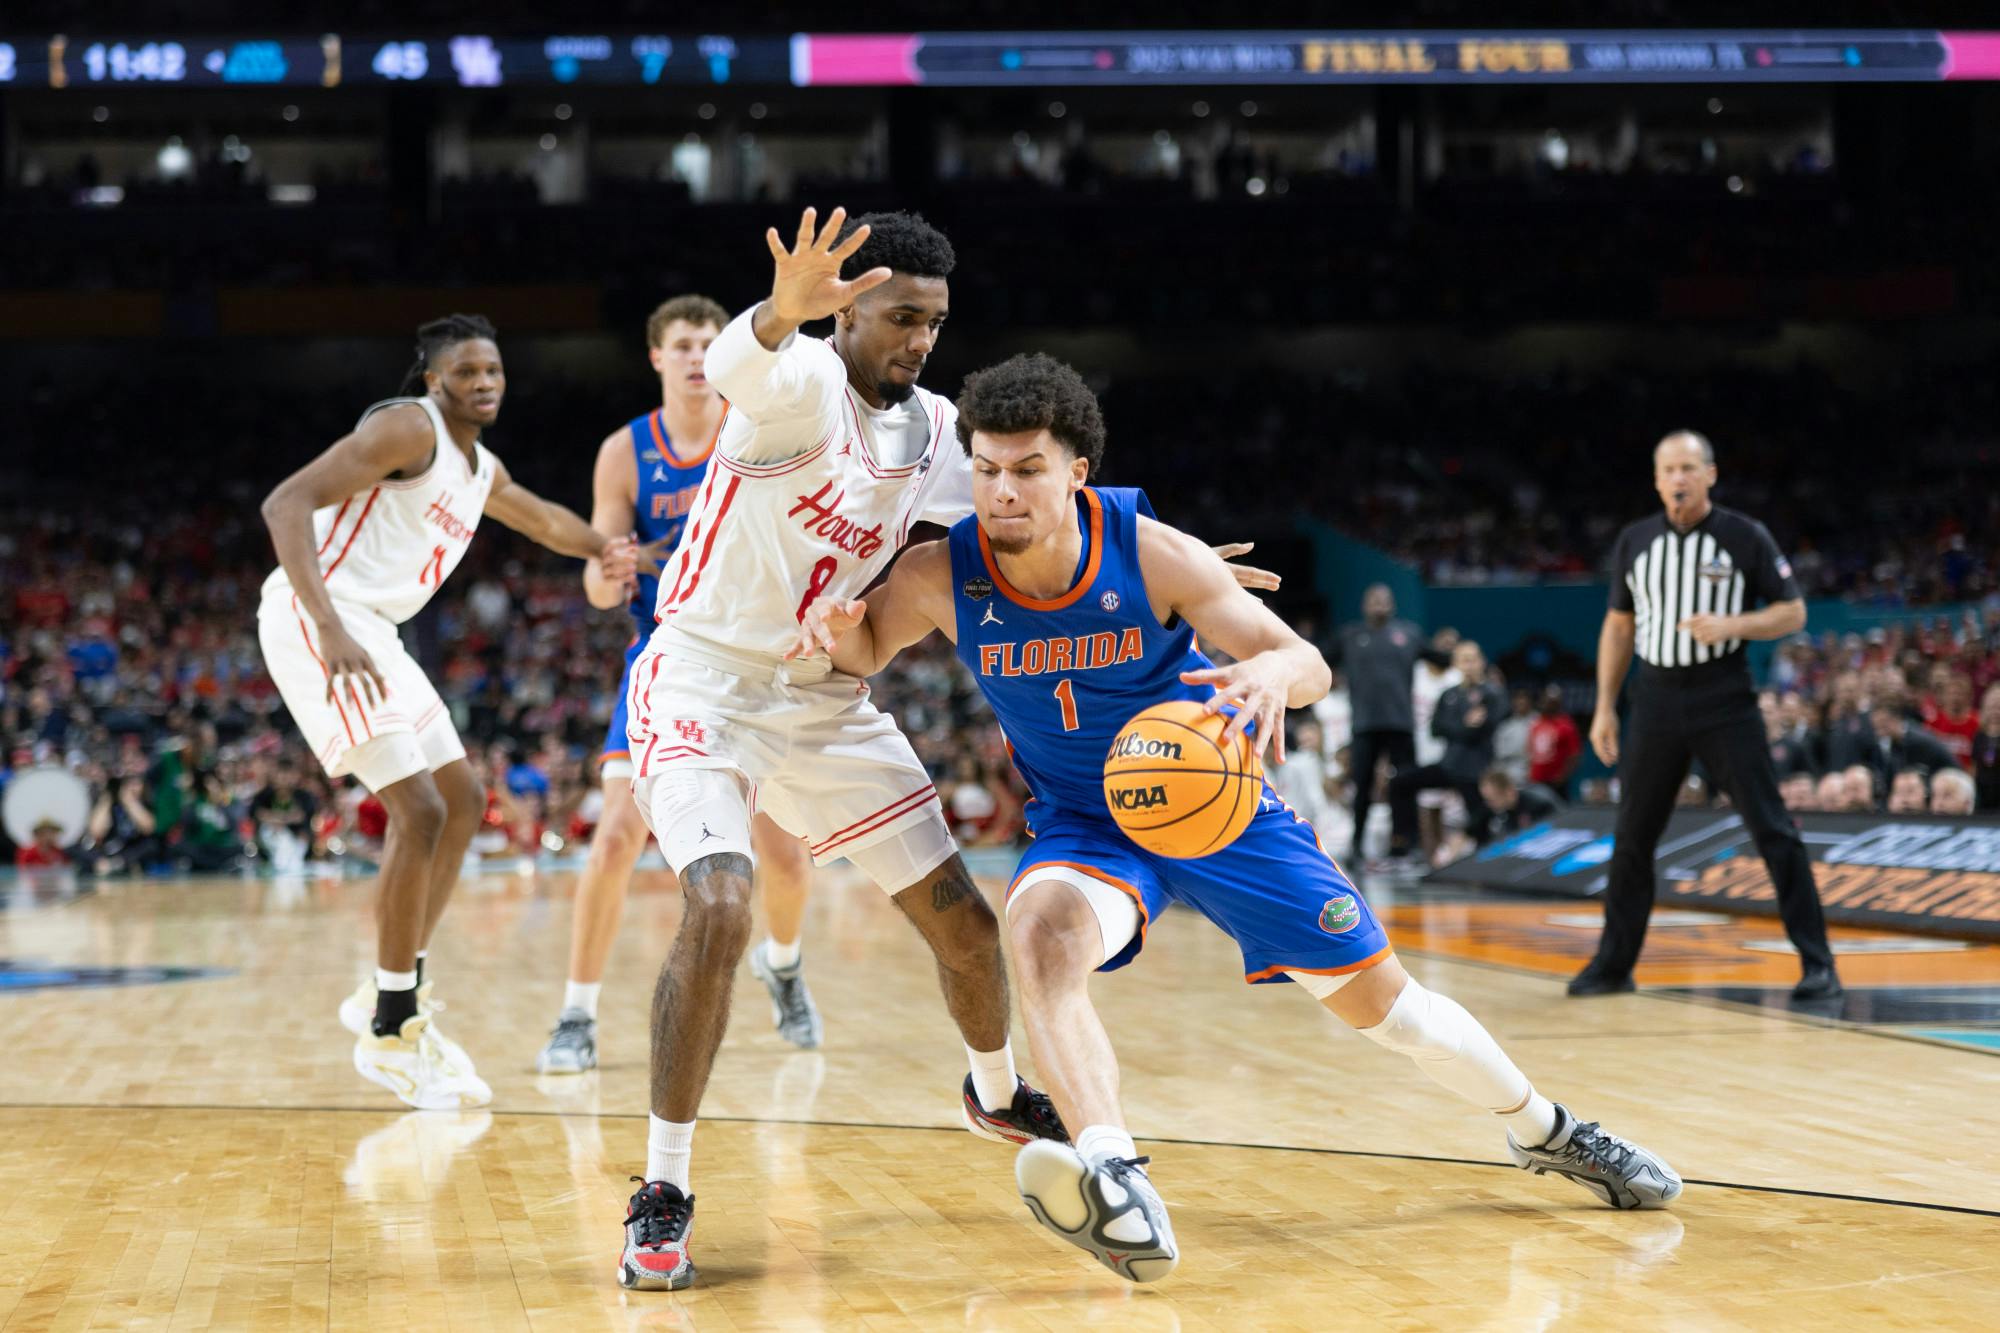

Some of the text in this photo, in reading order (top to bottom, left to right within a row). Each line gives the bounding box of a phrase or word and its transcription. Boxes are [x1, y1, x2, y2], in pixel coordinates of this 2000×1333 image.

[84, 43, 185, 80] 11:42
[372, 41, 429, 80] 45
[1303, 39, 1435, 73] FINAL
[1458, 38, 1571, 73] FOUR
[788, 480, 884, 559] Housto
[1103, 592, 1119, 610] SEC
[978, 627, 1143, 676] FLORIDA
[1054, 679, 1079, 732] 1
[1109, 785, 1168, 810] NCAA
